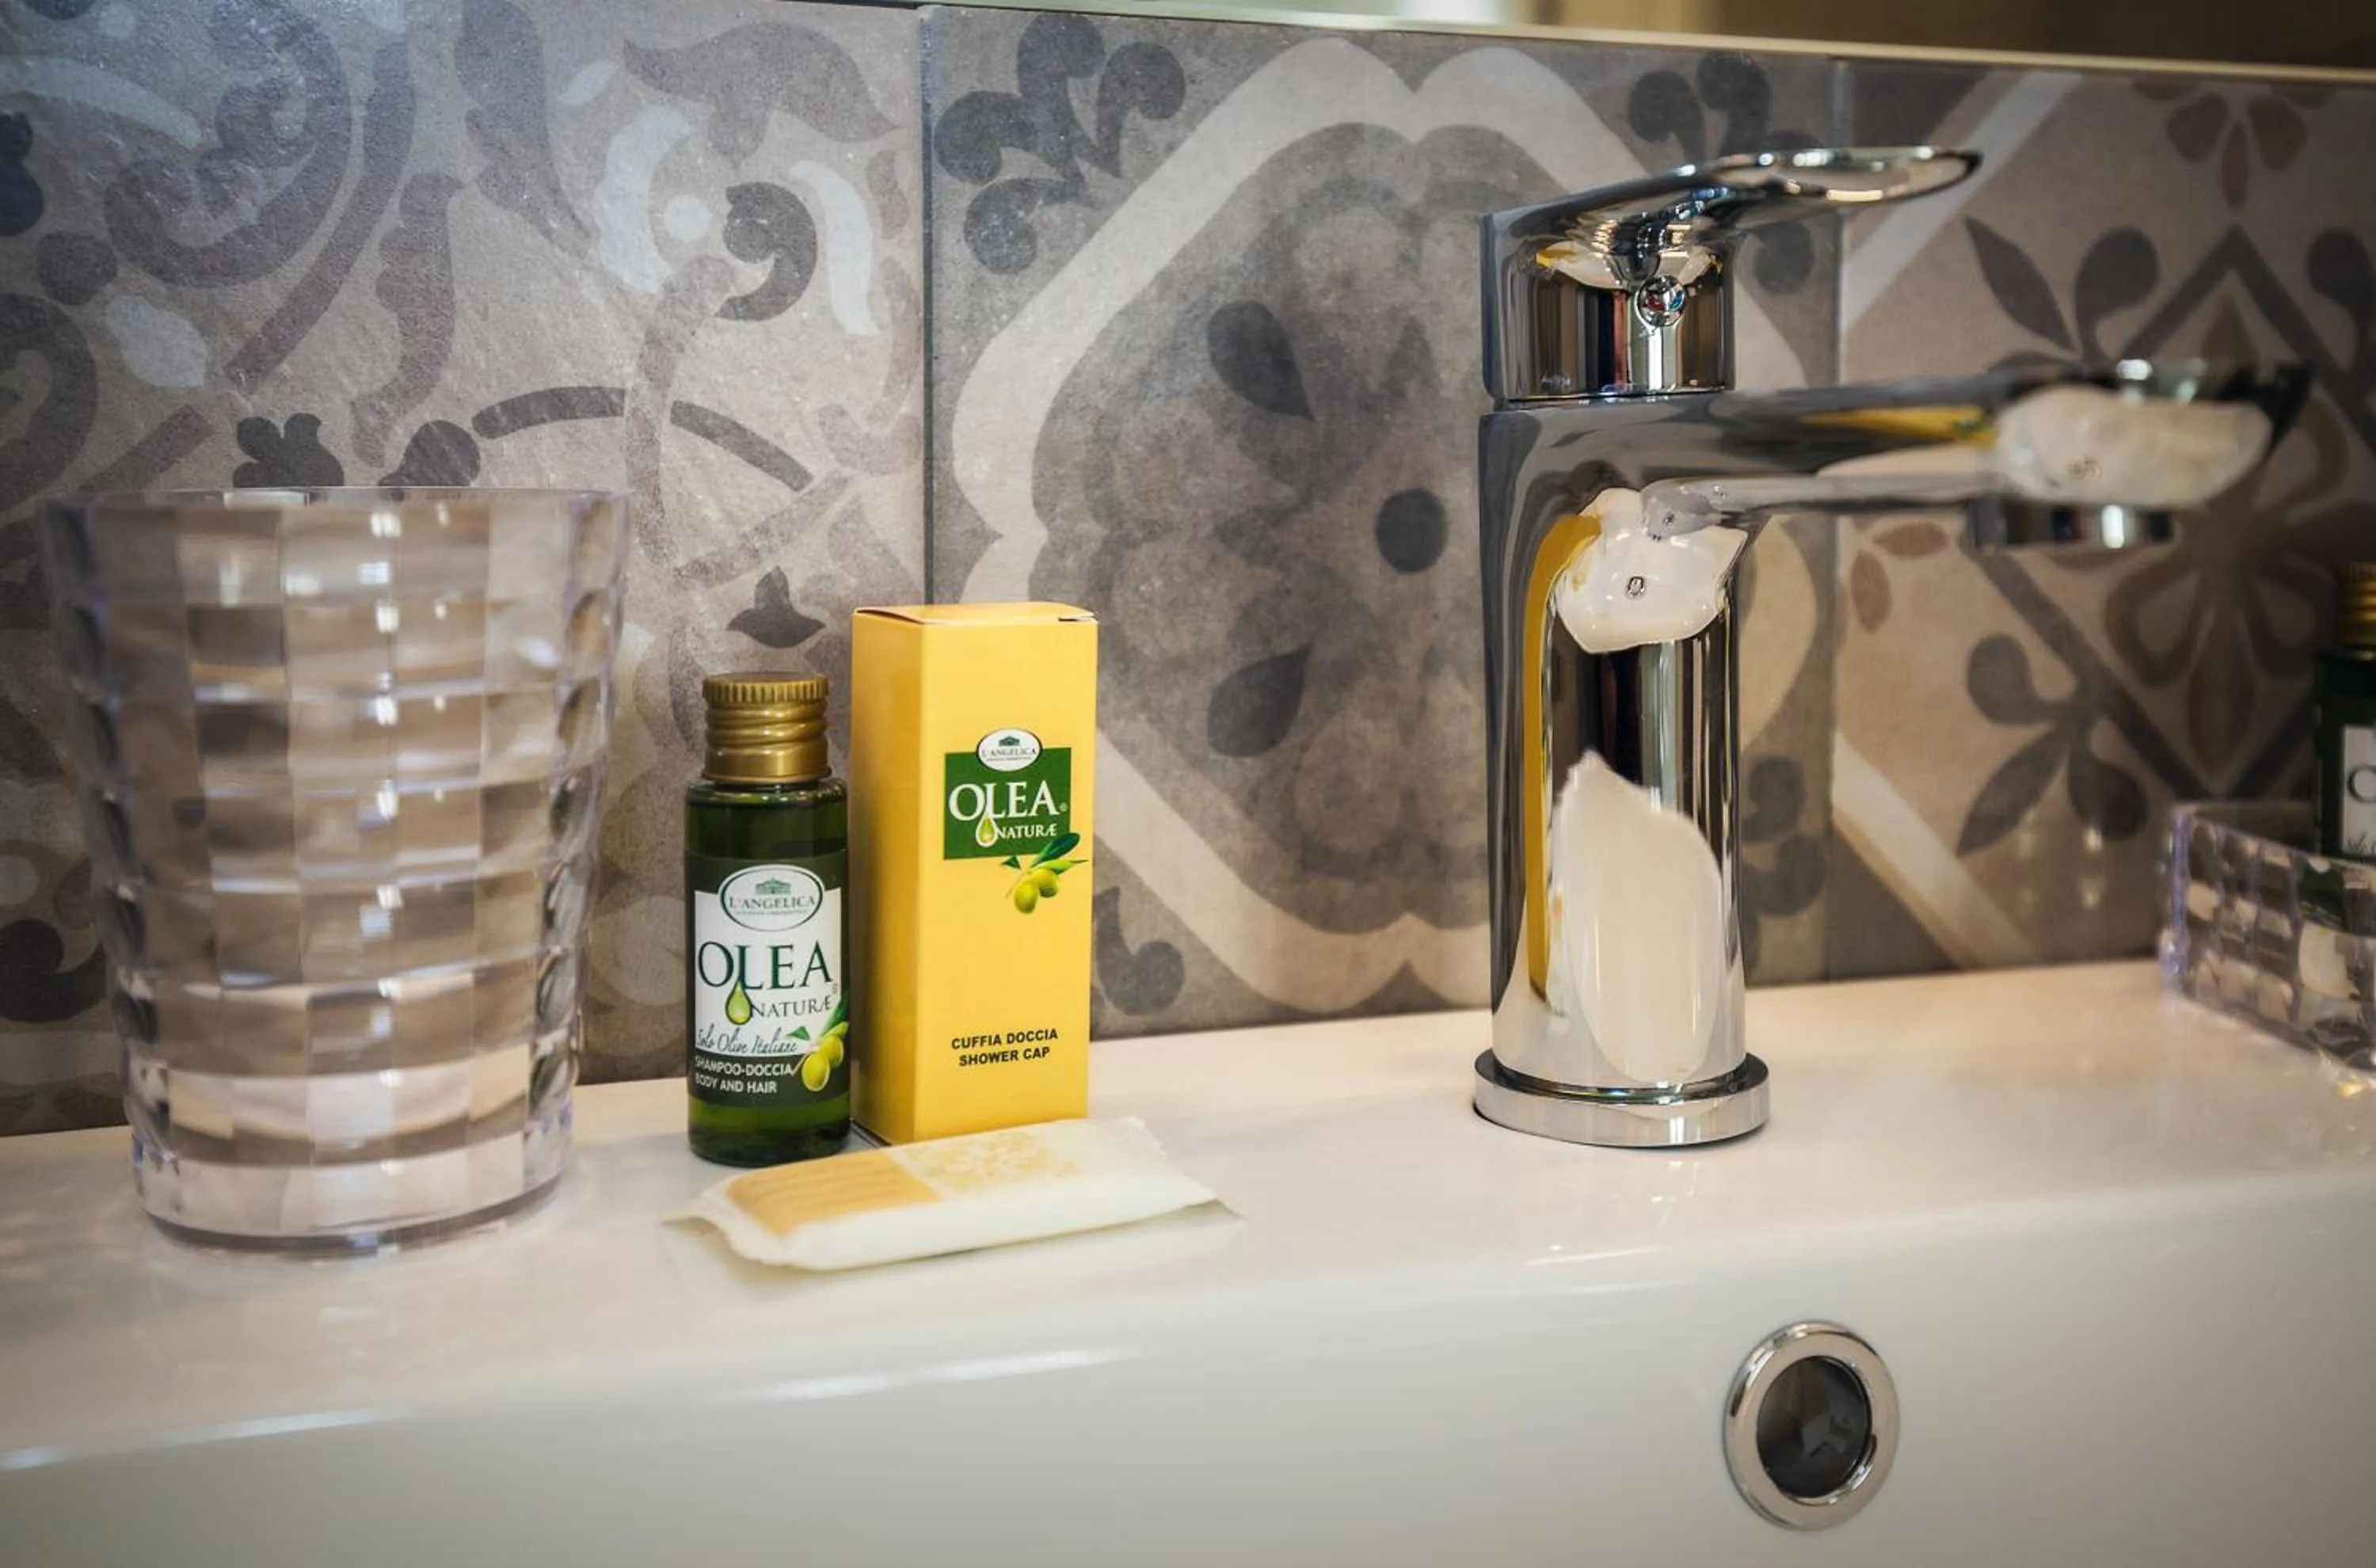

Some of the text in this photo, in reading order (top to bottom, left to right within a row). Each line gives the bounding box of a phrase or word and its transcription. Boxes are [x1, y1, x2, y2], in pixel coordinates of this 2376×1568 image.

[949, 780, 1060, 820] OLEA
[729, 895, 816, 910] L'ANGELICA
[698, 941, 833, 989] OLEA
[950, 1029, 1058, 1049] CUFFIA DOCCIA
[959, 1046, 1050, 1066] SHOWER CAP
[695, 1071, 778, 1094] BODY AND HAIR
